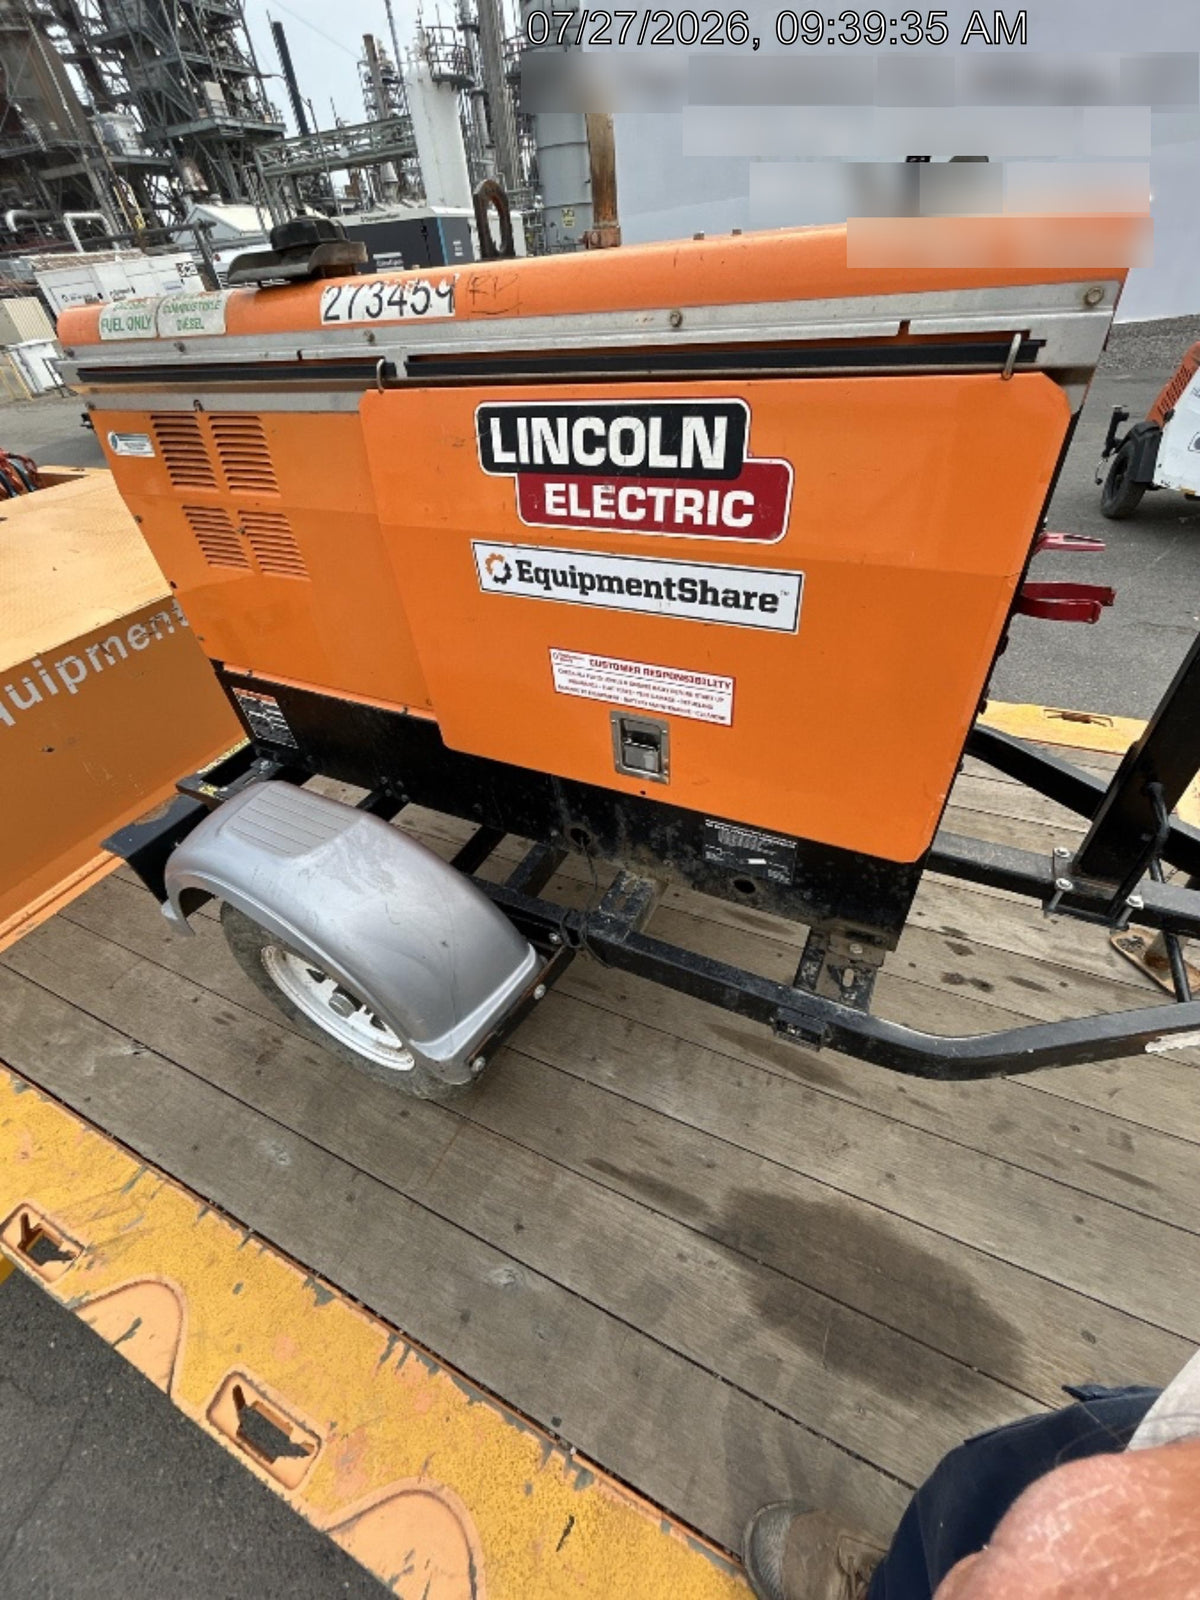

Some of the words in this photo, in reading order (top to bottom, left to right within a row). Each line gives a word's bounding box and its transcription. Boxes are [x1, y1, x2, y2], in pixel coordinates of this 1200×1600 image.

[101, 317, 125, 333] FUEL
[126, 314, 153, 331] ONLY
[489, 415, 728, 470] LINCOLN
[543, 482, 755, 528] ELECTRIC
[514, 559, 779, 613] EquipmentShare
[589, 658, 641, 675] CUSTOMER
[643, 665, 732, 690] RESPONSIBILITY
